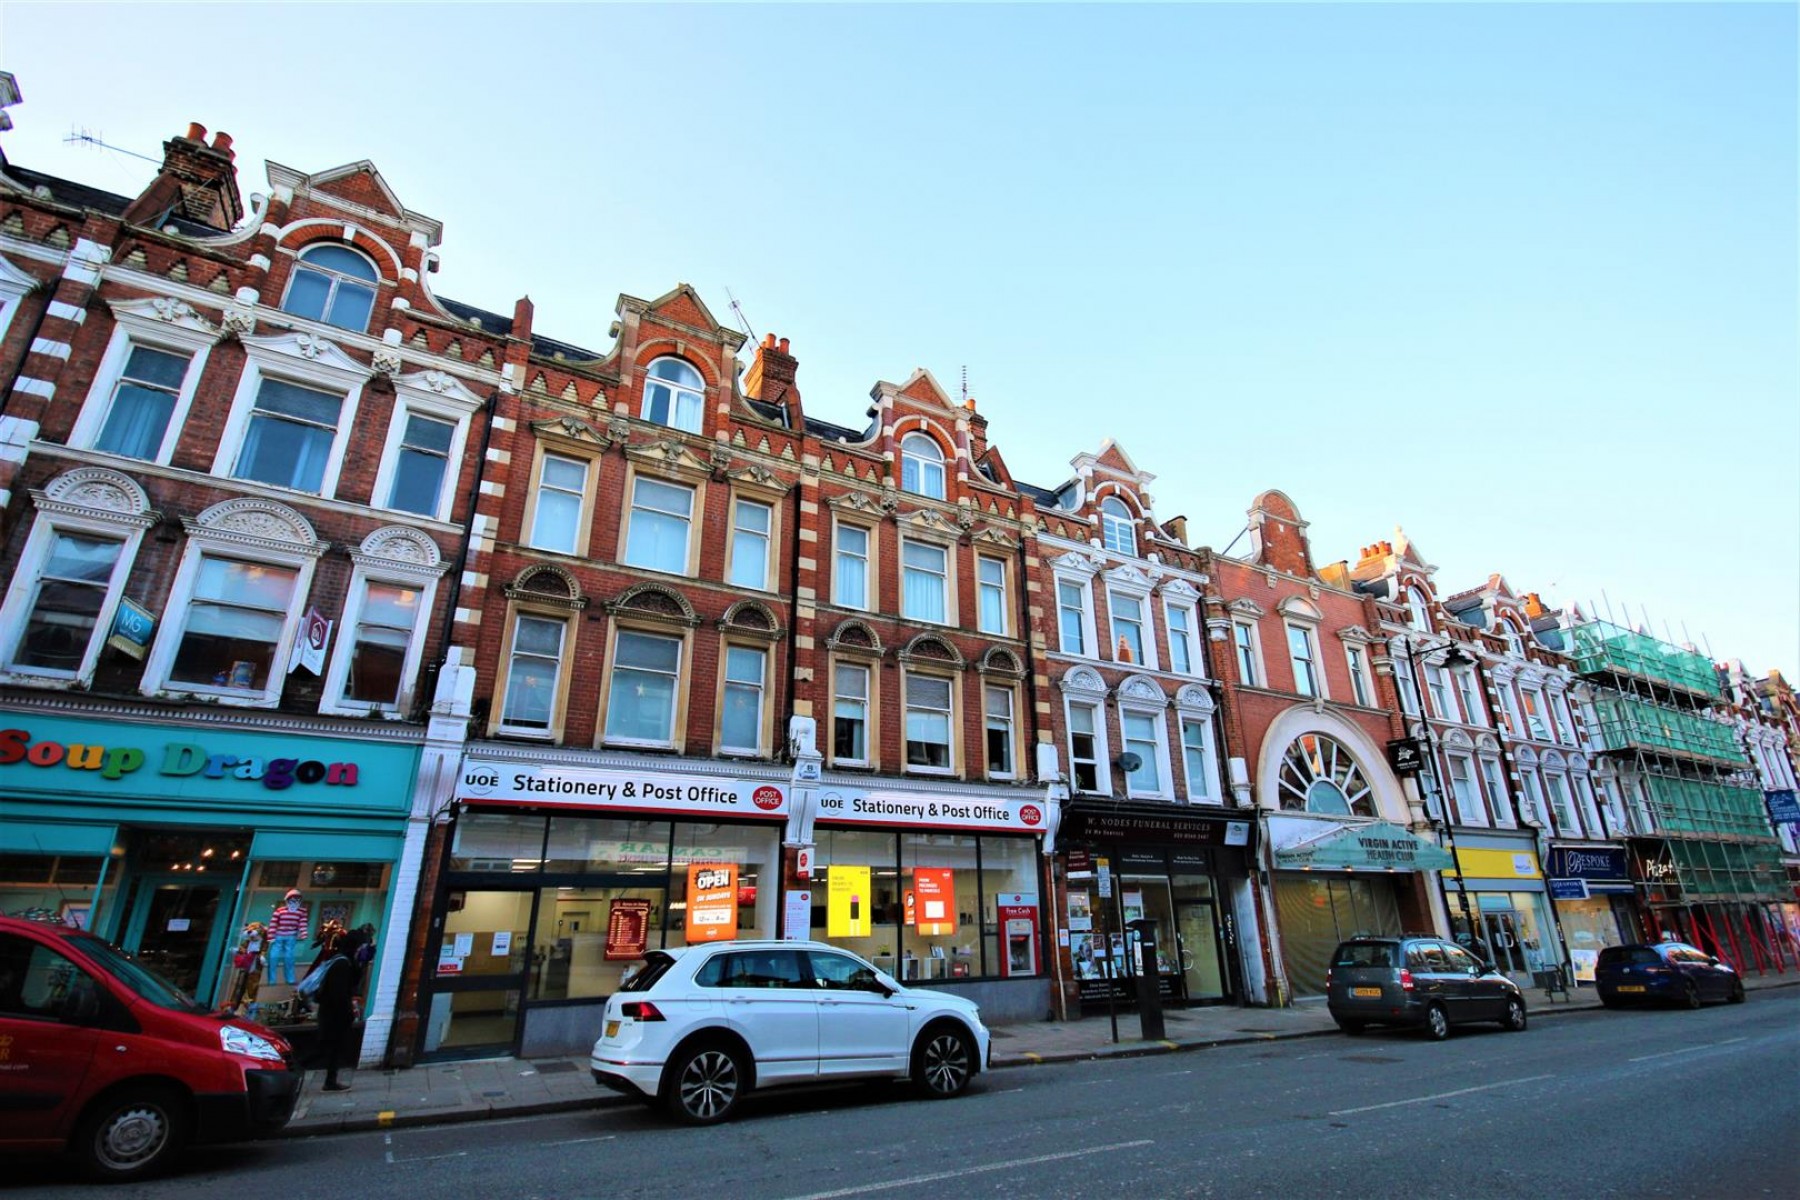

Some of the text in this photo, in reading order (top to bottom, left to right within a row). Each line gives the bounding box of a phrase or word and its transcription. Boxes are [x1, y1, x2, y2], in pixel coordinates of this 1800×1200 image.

[122, 610, 142, 633] MG
[0, 728, 359, 790] Soup Dragon
[465, 774, 738, 804] UOE Stationery & Post Office
[759, 790, 778, 798] POST
[755, 797, 780, 805] OFFICE
[820, 799, 1010, 820] UOE Stationery & Post Office
[1101, 818, 1130, 827] NODES
[1133, 819, 1171, 829] FUNERAL
[1358, 837, 1419, 850] VIRGIN ACTIVE
[1366, 850, 1415, 861] HEALTH CLUB
[697, 873, 730, 890] OPEN
